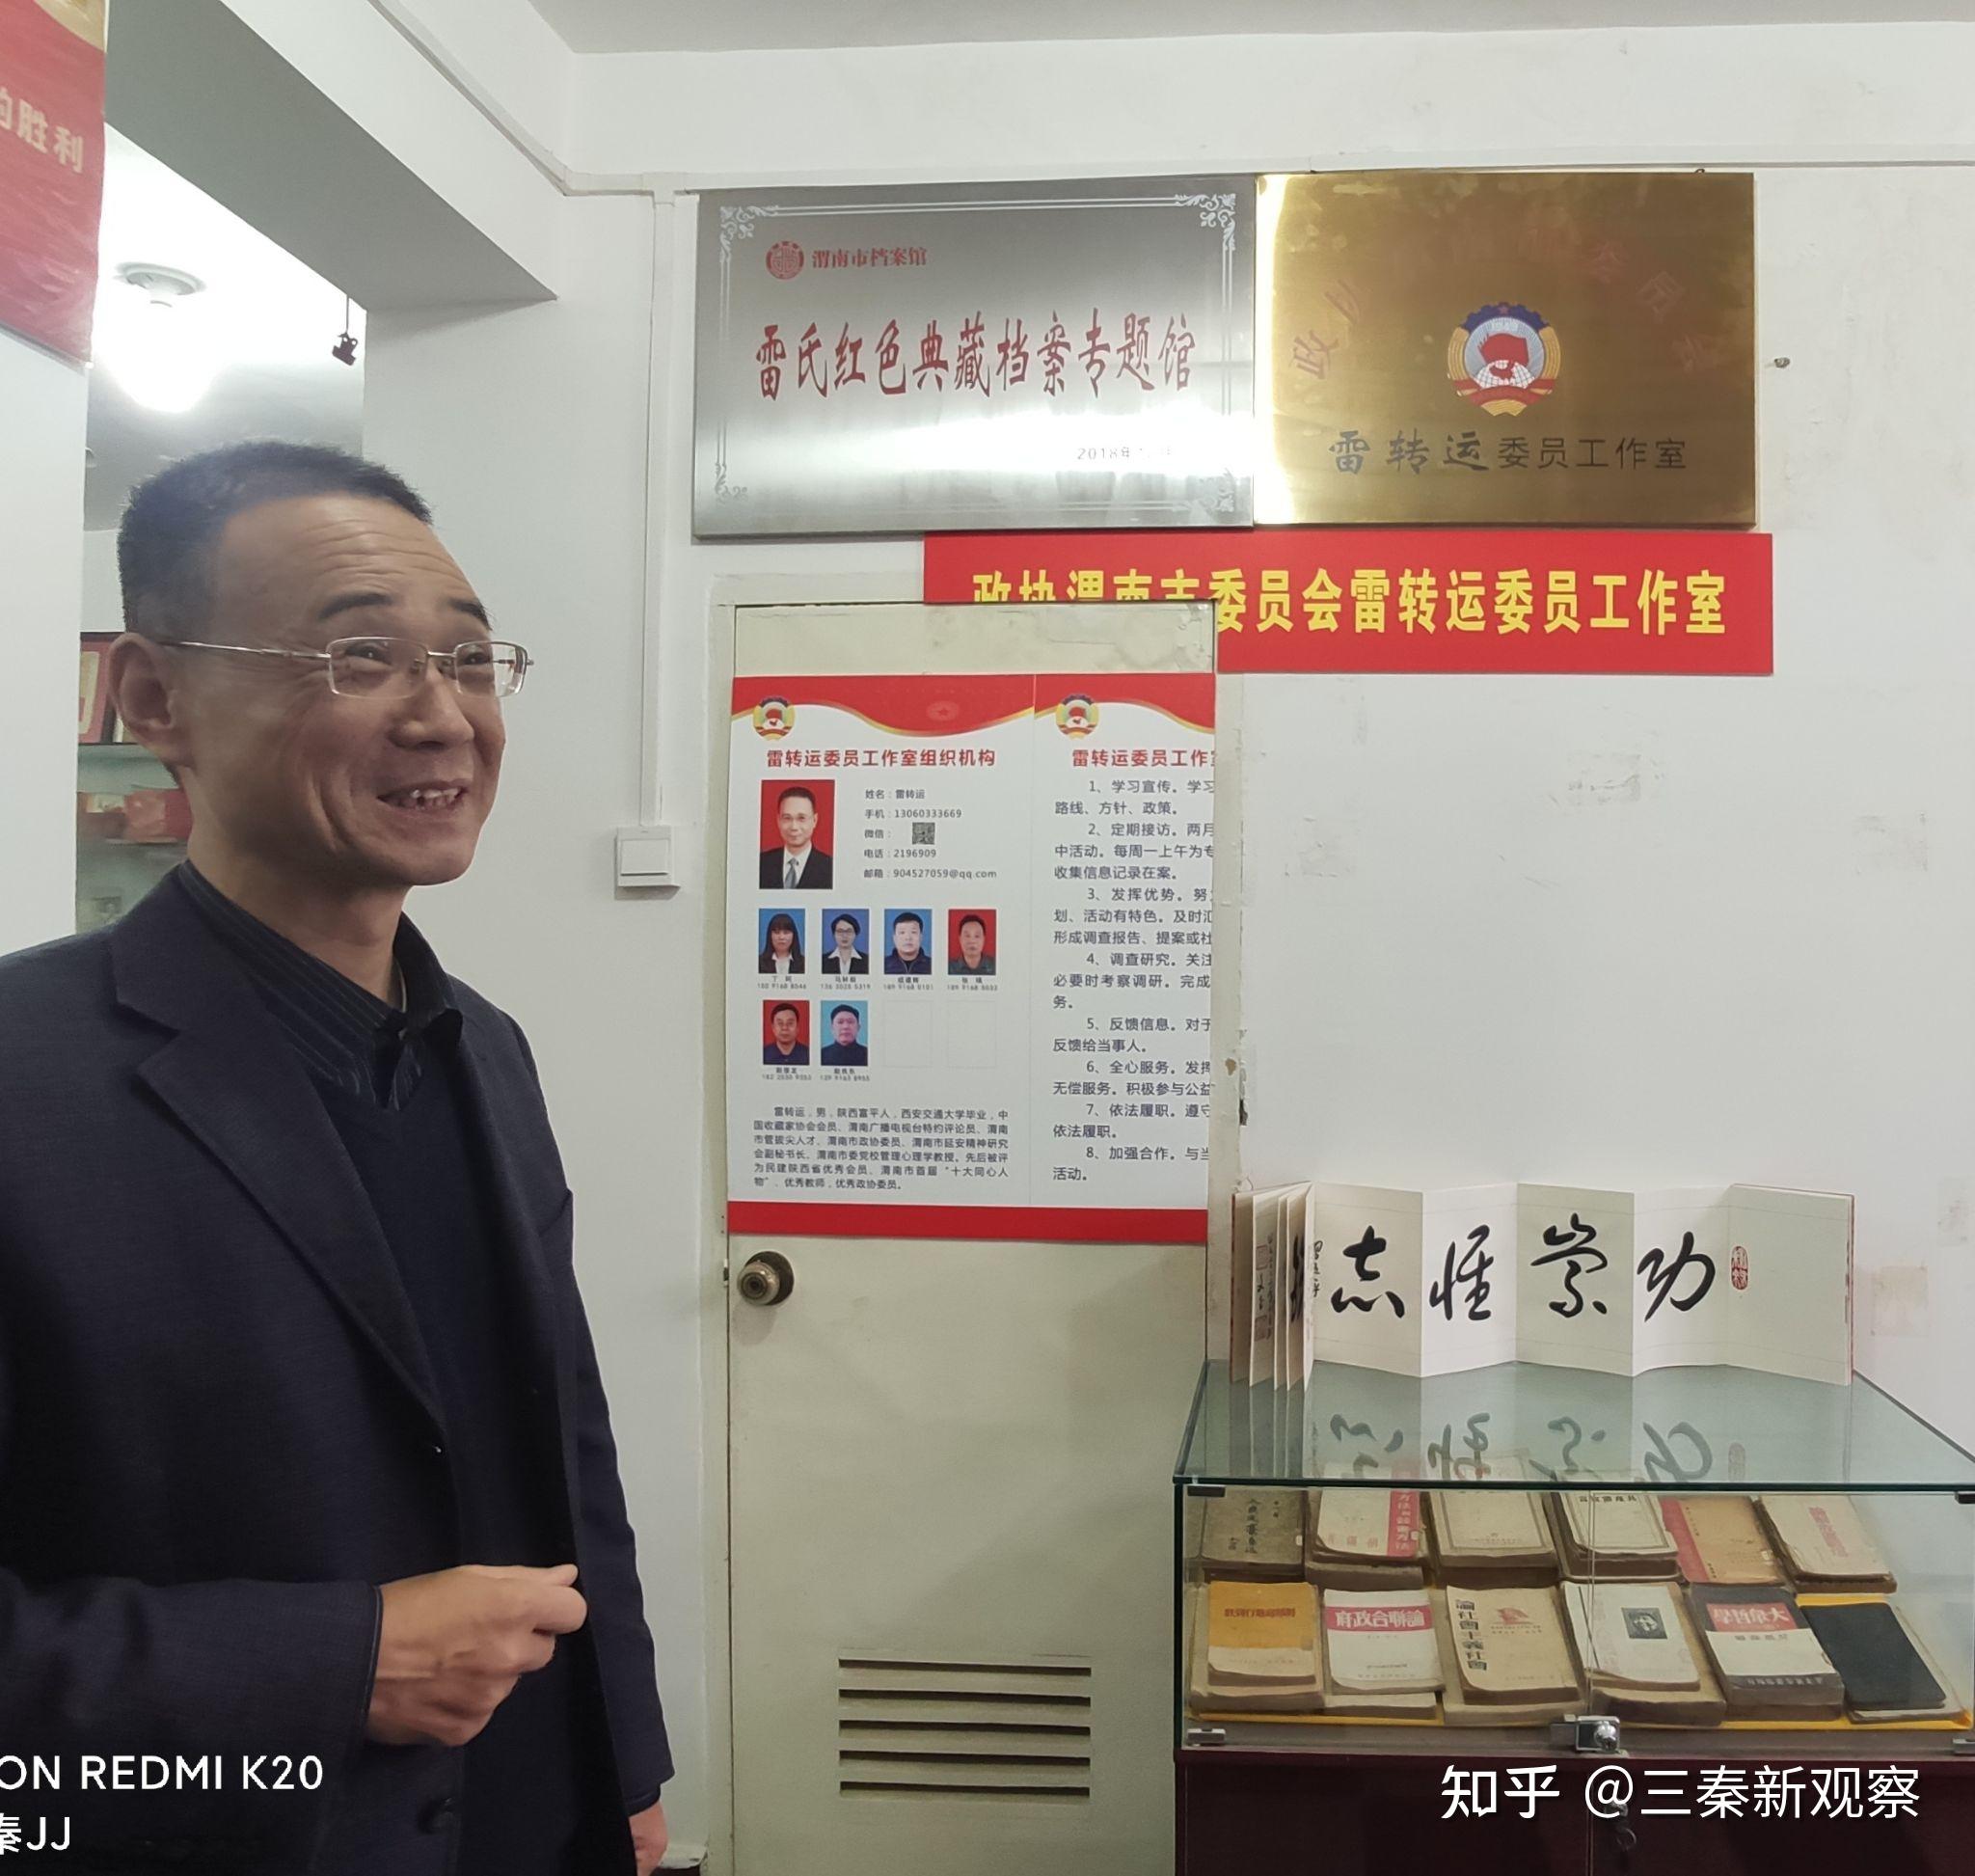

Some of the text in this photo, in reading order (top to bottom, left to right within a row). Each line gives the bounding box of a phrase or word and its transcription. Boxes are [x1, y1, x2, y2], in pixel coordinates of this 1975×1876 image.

[811, 248, 927, 270] 渭南市档案馆
[755, 308, 1196, 402] 雷氏红色典藏档案专题馆
[1329, 427, 1687, 475] 雷转运委员工作室
[767, 748, 996, 769] 雷转运委员工作室组织机构
[1054, 865, 1177, 881] 收集信息记录在案。
[1087, 887, 1213, 903] 3、发挥优势。努
[1053, 995, 1073, 1010] 务。
[1053, 1039, 1148, 1053] 反馈给当事人。
[1053, 1125, 1118, 1139] 依法履职。
[1053, 1167, 1088, 1182] 活动。
